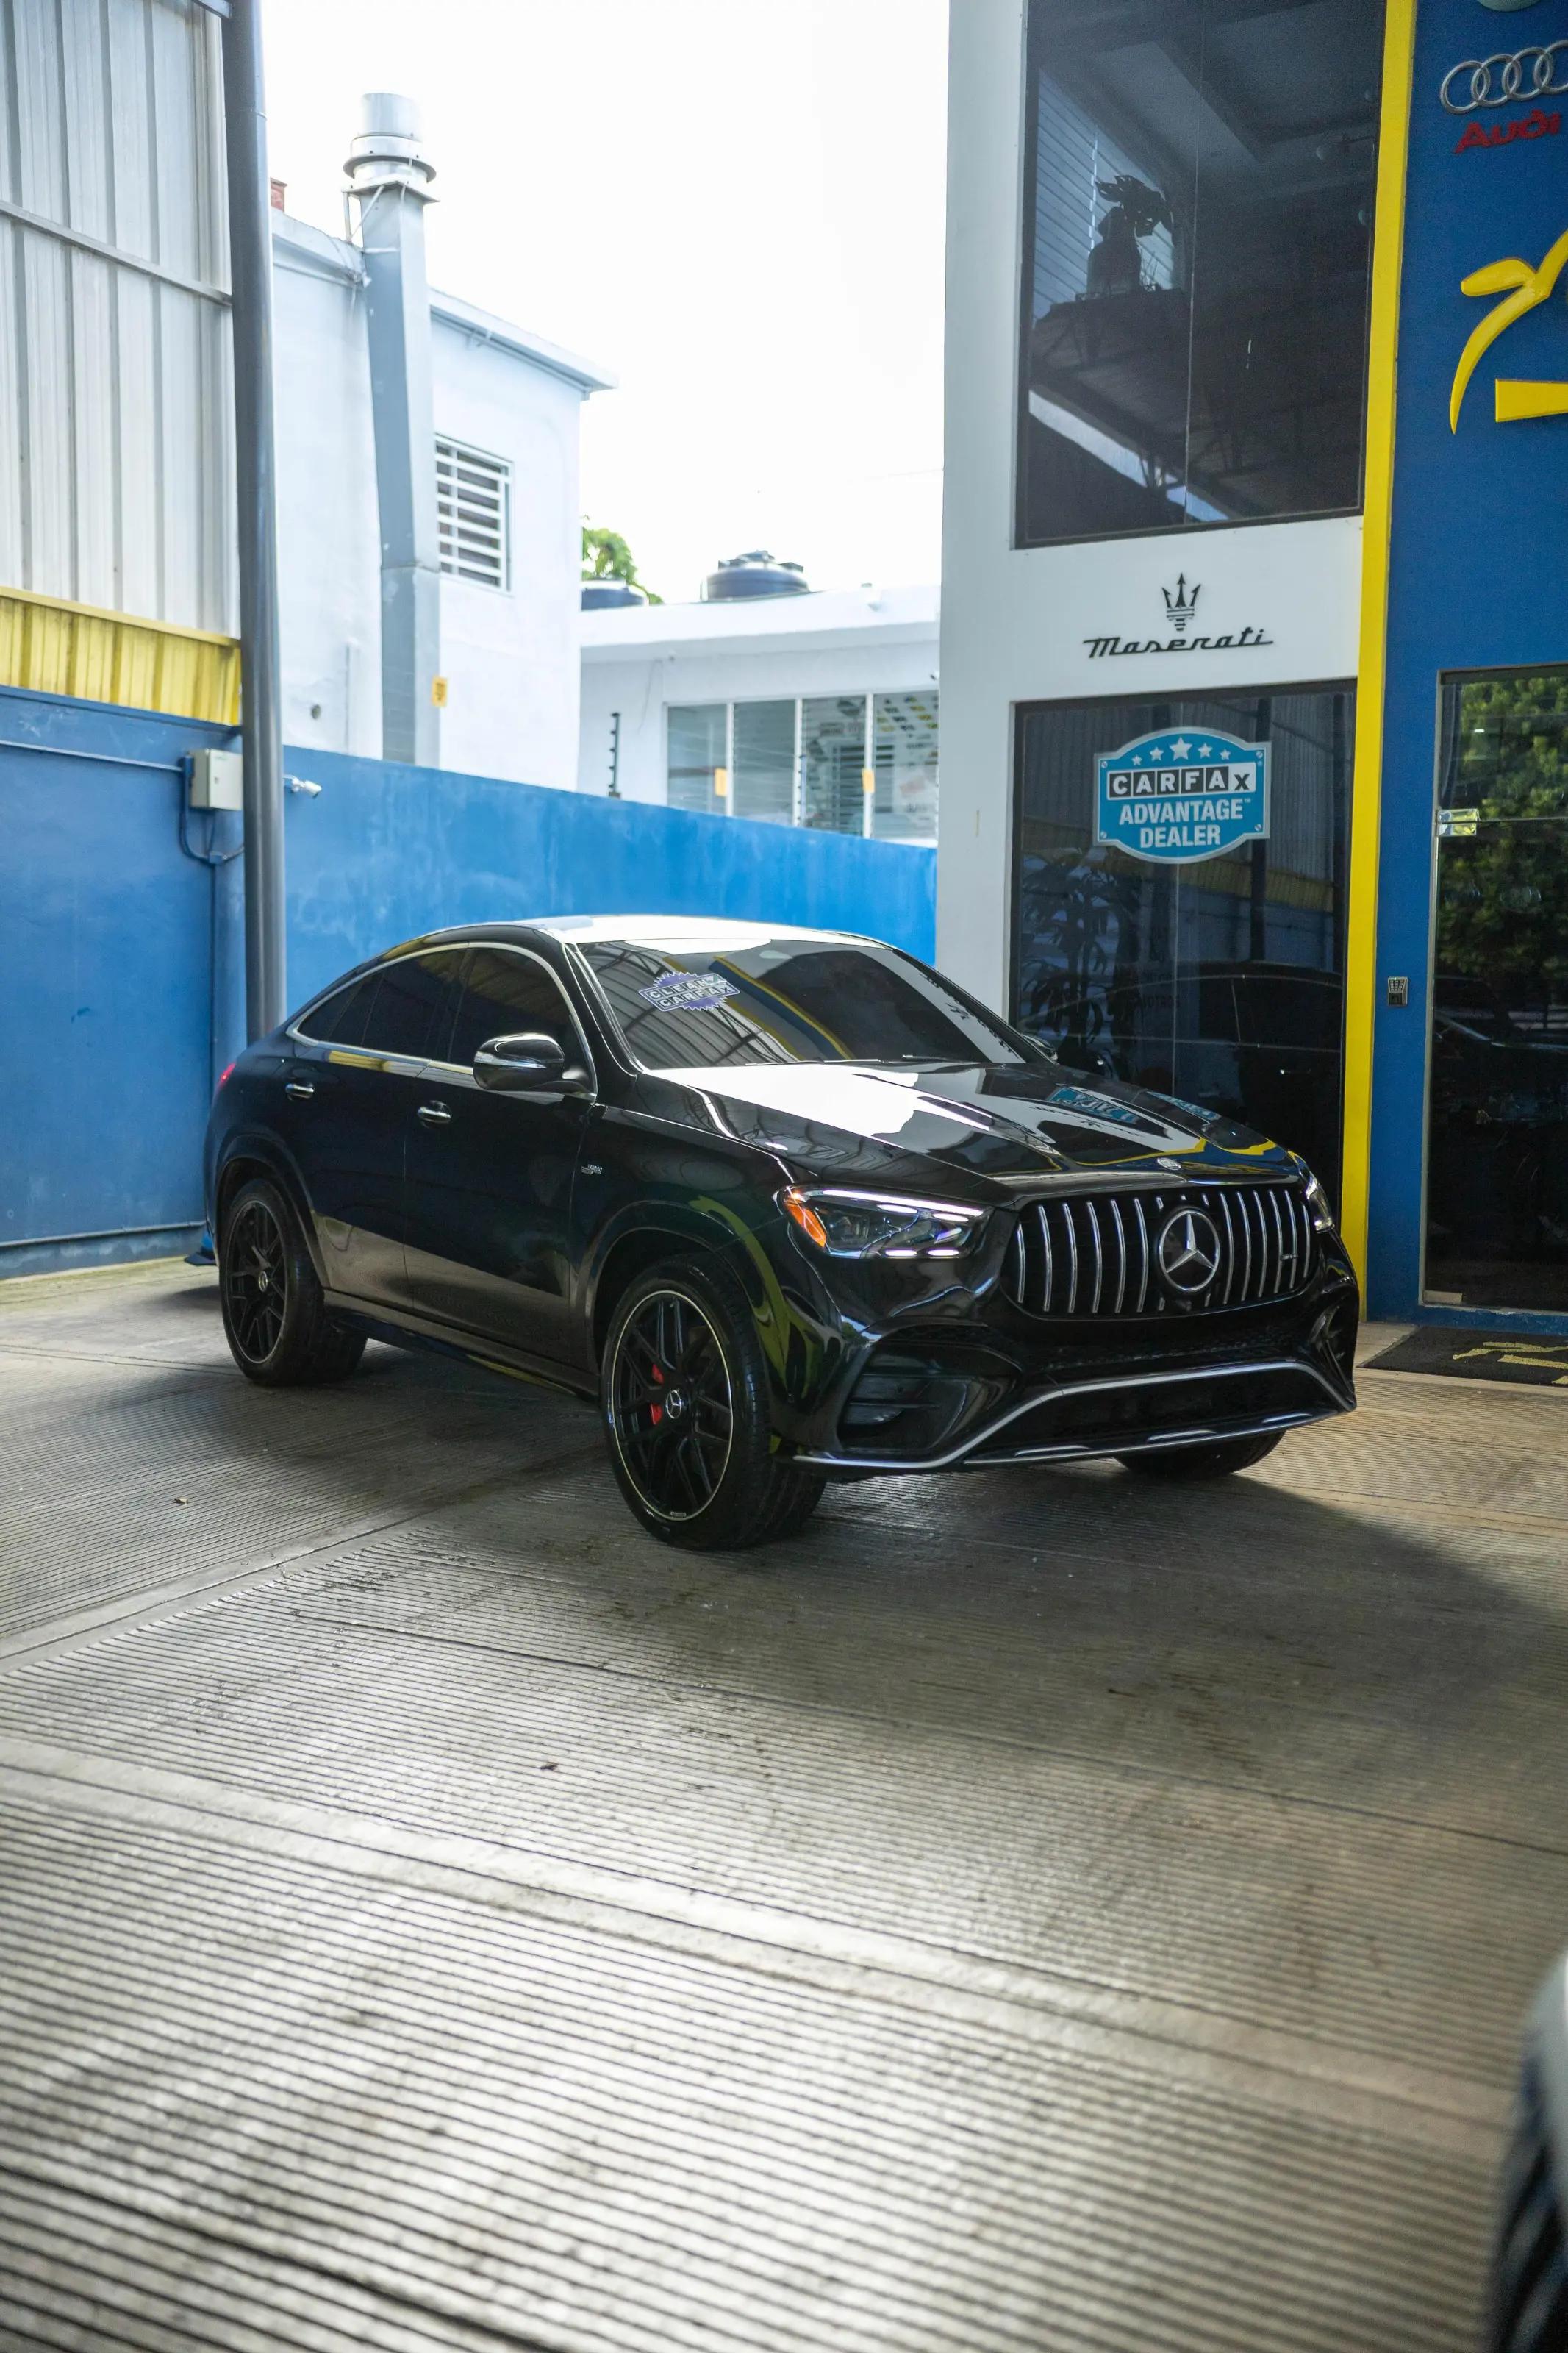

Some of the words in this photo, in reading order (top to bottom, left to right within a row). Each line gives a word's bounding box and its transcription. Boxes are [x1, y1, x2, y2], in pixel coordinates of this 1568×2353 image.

[1454, 110, 1561, 154] Audi
[1083, 626, 1274, 658] Maserati
[1112, 769, 1251, 795] CARFAX
[1140, 825, 1221, 848] DEALER
[650, 979, 708, 999] CLEAN
[660, 986, 731, 1007] CARFAX
